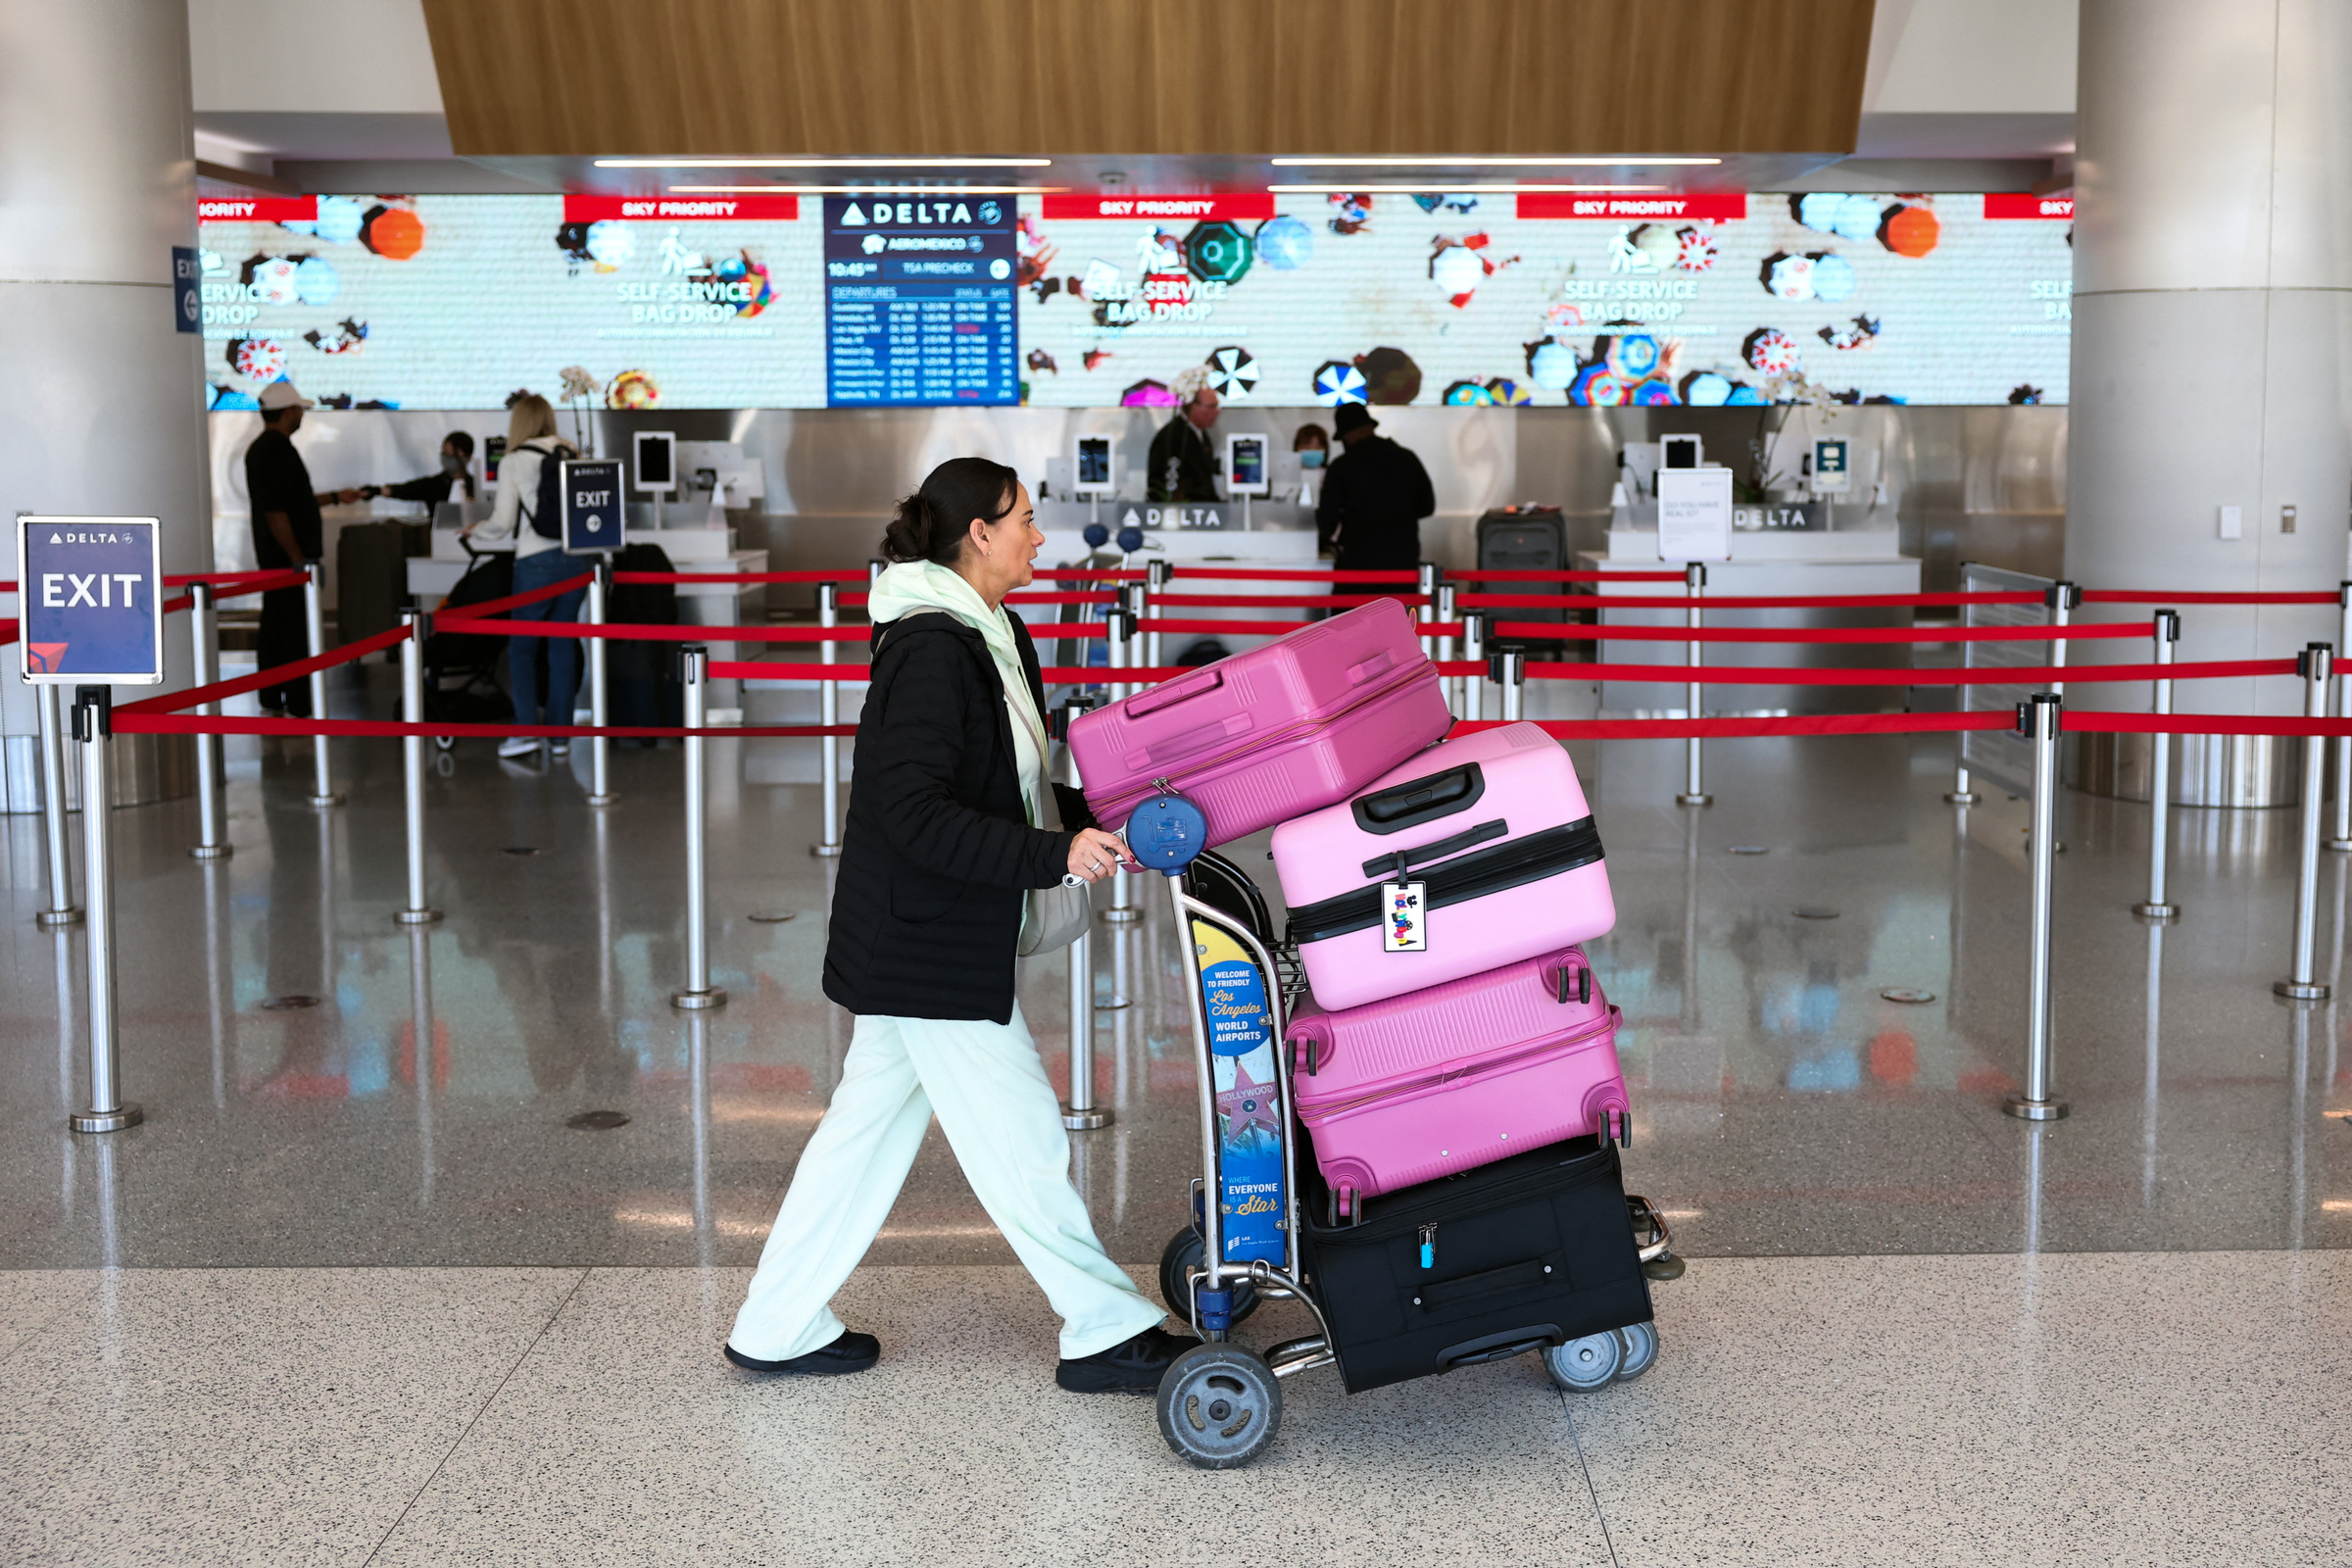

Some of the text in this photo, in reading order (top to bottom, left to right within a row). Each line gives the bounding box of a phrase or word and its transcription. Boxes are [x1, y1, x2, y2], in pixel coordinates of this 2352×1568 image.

[199, 202, 255, 217] IORITY
[621, 202, 736, 216] SKY PRIORITY
[873, 203, 972, 223] DELTA
[1099, 201, 1213, 215] SKY PRIORITY
[1573, 201, 1686, 215] SKY PRIORITY
[2039, 201, 2074, 215] SKY
[201, 283, 270, 303] ERVICE
[615, 282, 753, 302] SELF-SERVICE
[1093, 280, 1227, 301] SELF-SERVICE
[1564, 280, 1698, 300] SELF-SERVICE
[202, 306, 259, 324] DROP
[632, 304, 737, 323] BAG DROP
[1106, 303, 1212, 321] BAG DROP
[1579, 302, 1683, 321] BAG DROP
[2044, 301, 2073, 320] BA
[576, 490, 611, 508] EXIT
[1734, 509, 1805, 526] DELTA
[67, 533, 118, 543] DELTA
[42, 573, 142, 608] EXIT
[1218, 979, 1250, 988] FRIENDLY
[1209, 989, 1235, 1005] Los
[1211, 1002, 1261, 1018] Angeles
[1215, 1021, 1249, 1031] WORLD
[1215, 1031, 1261, 1042] AIRPORTS
[1219, 1085, 1273, 1102] HOLLYWOOD
[1229, 1183, 1278, 1195] EVERYONE
[1235, 1195, 1278, 1215] Star
